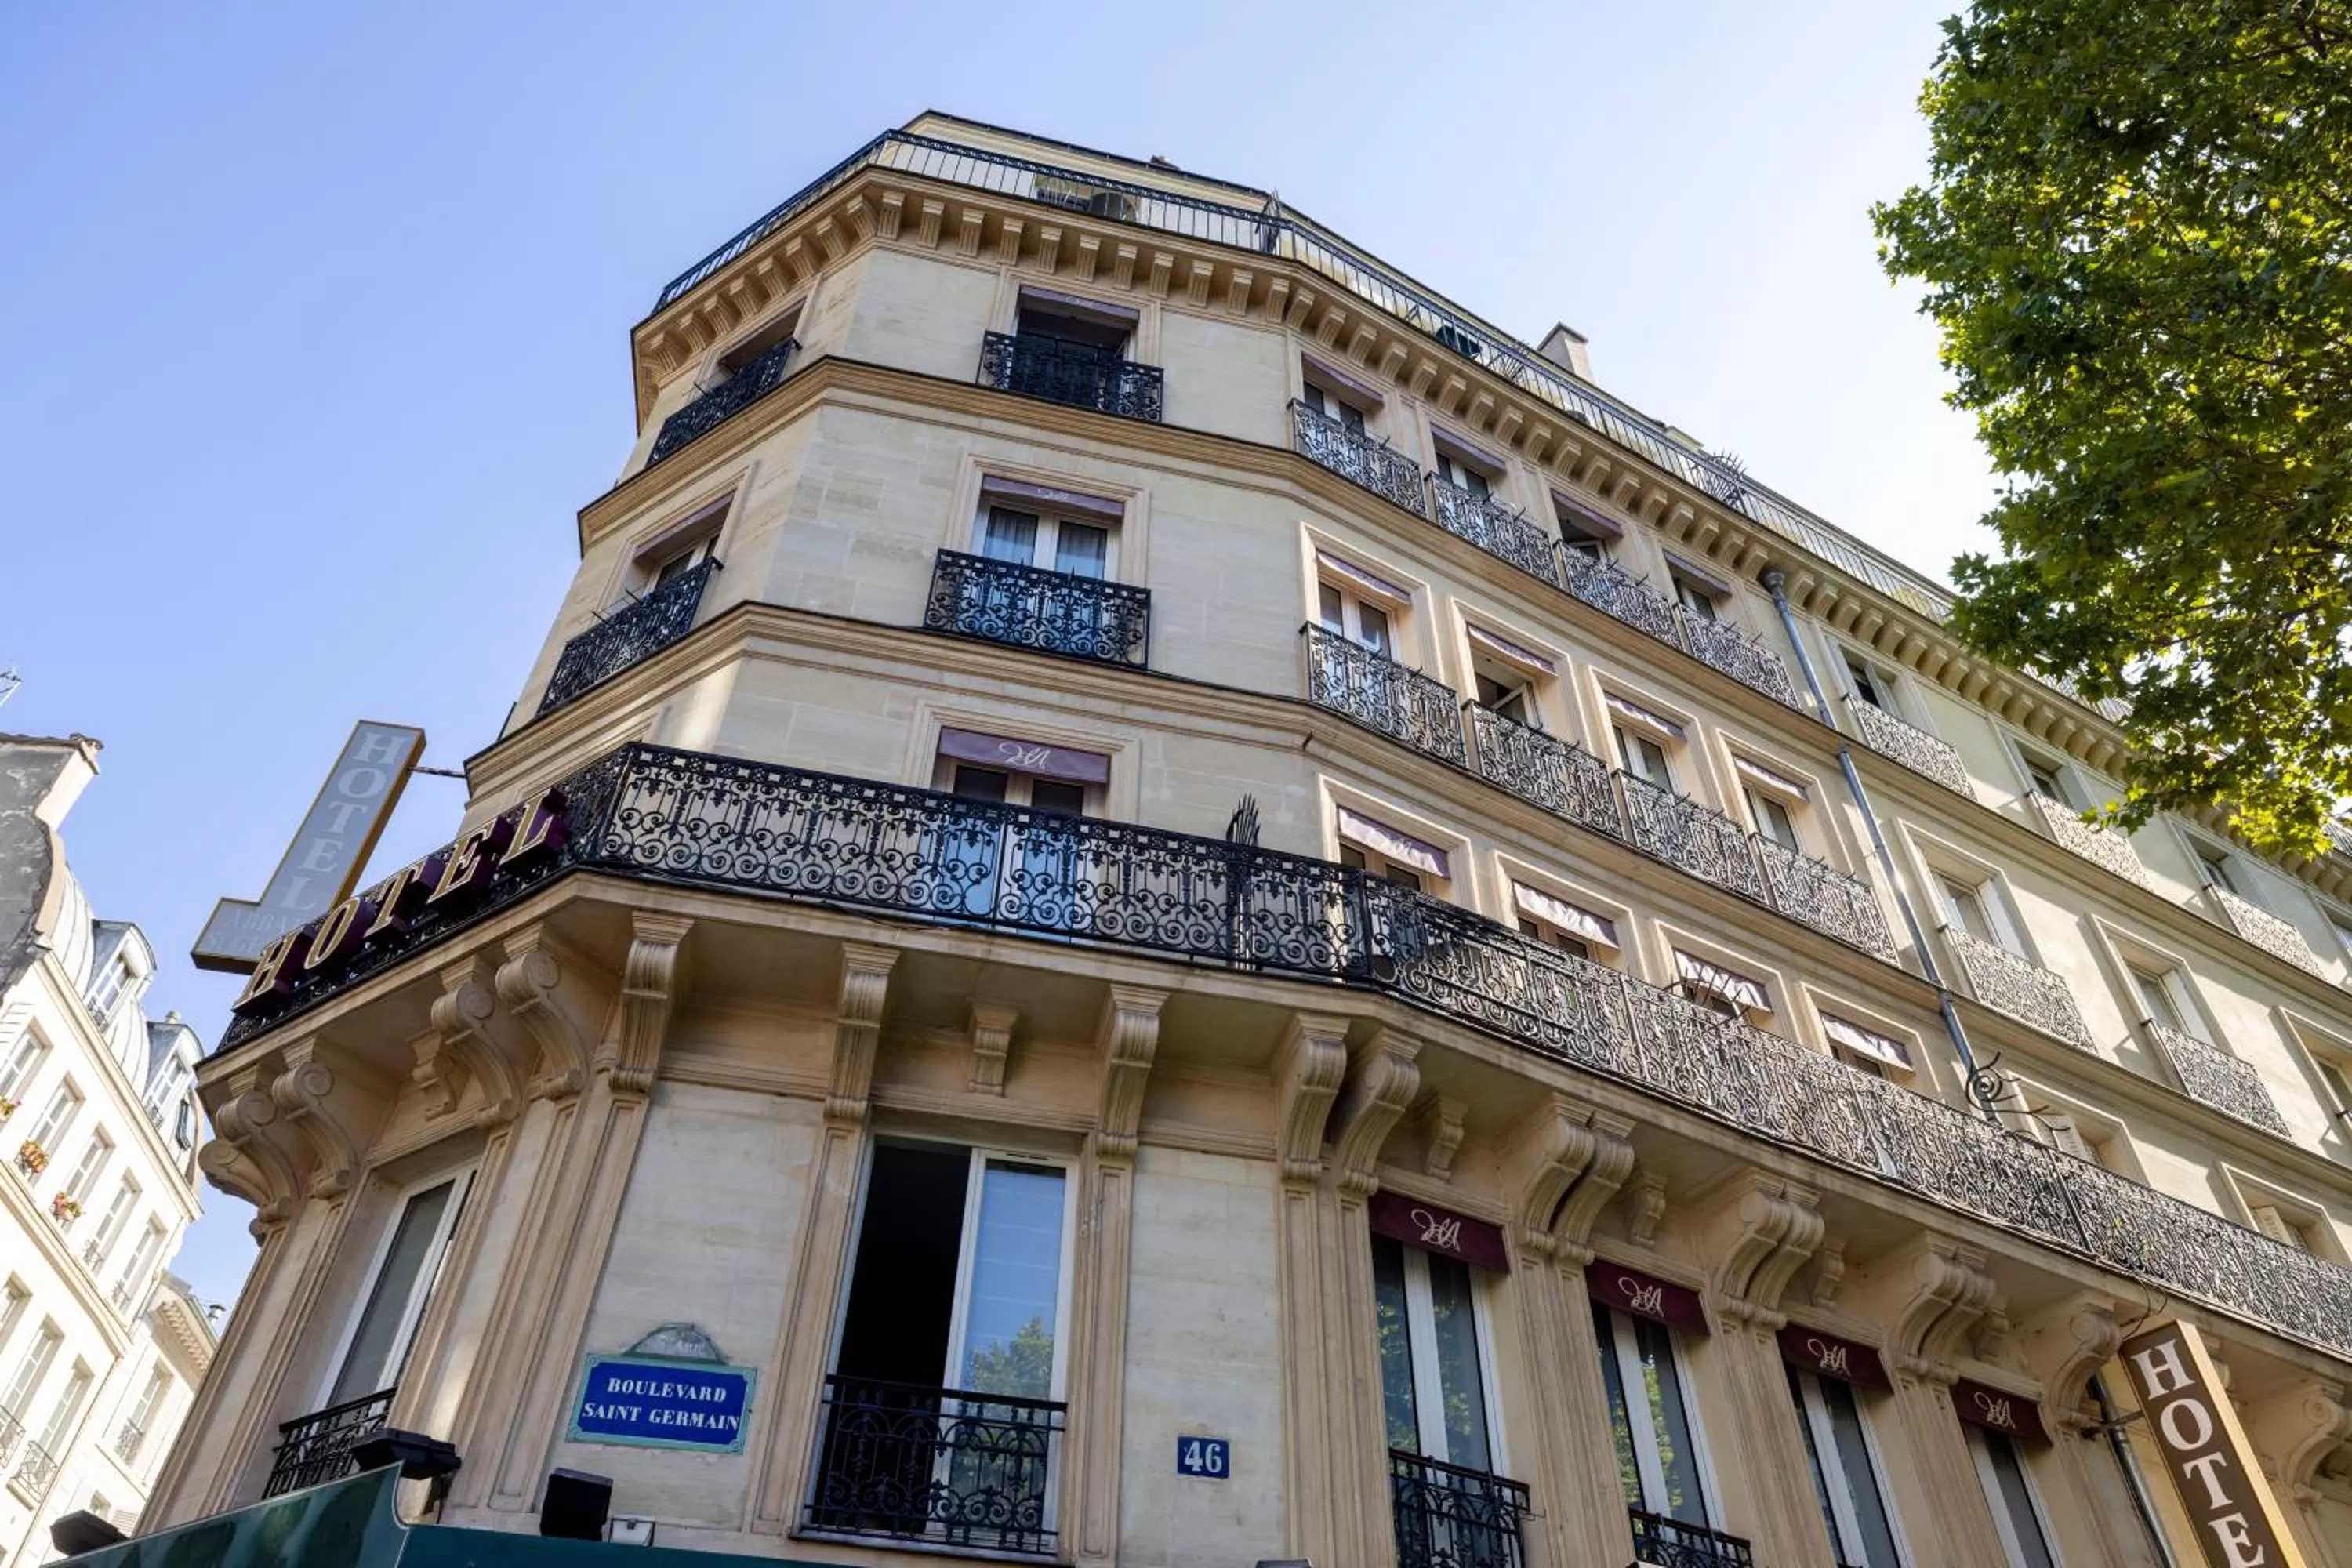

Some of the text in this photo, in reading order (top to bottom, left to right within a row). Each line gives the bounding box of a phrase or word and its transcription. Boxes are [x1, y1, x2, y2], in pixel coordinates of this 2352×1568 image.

[282, 731, 409, 912] HOTEL
[234, 788, 558, 1011] HOTEL
[608, 1377, 728, 1403] BOULEVARD
[582, 1403, 741, 1431] SAINT GERMAIN
[1185, 1440, 1222, 1473] 46
